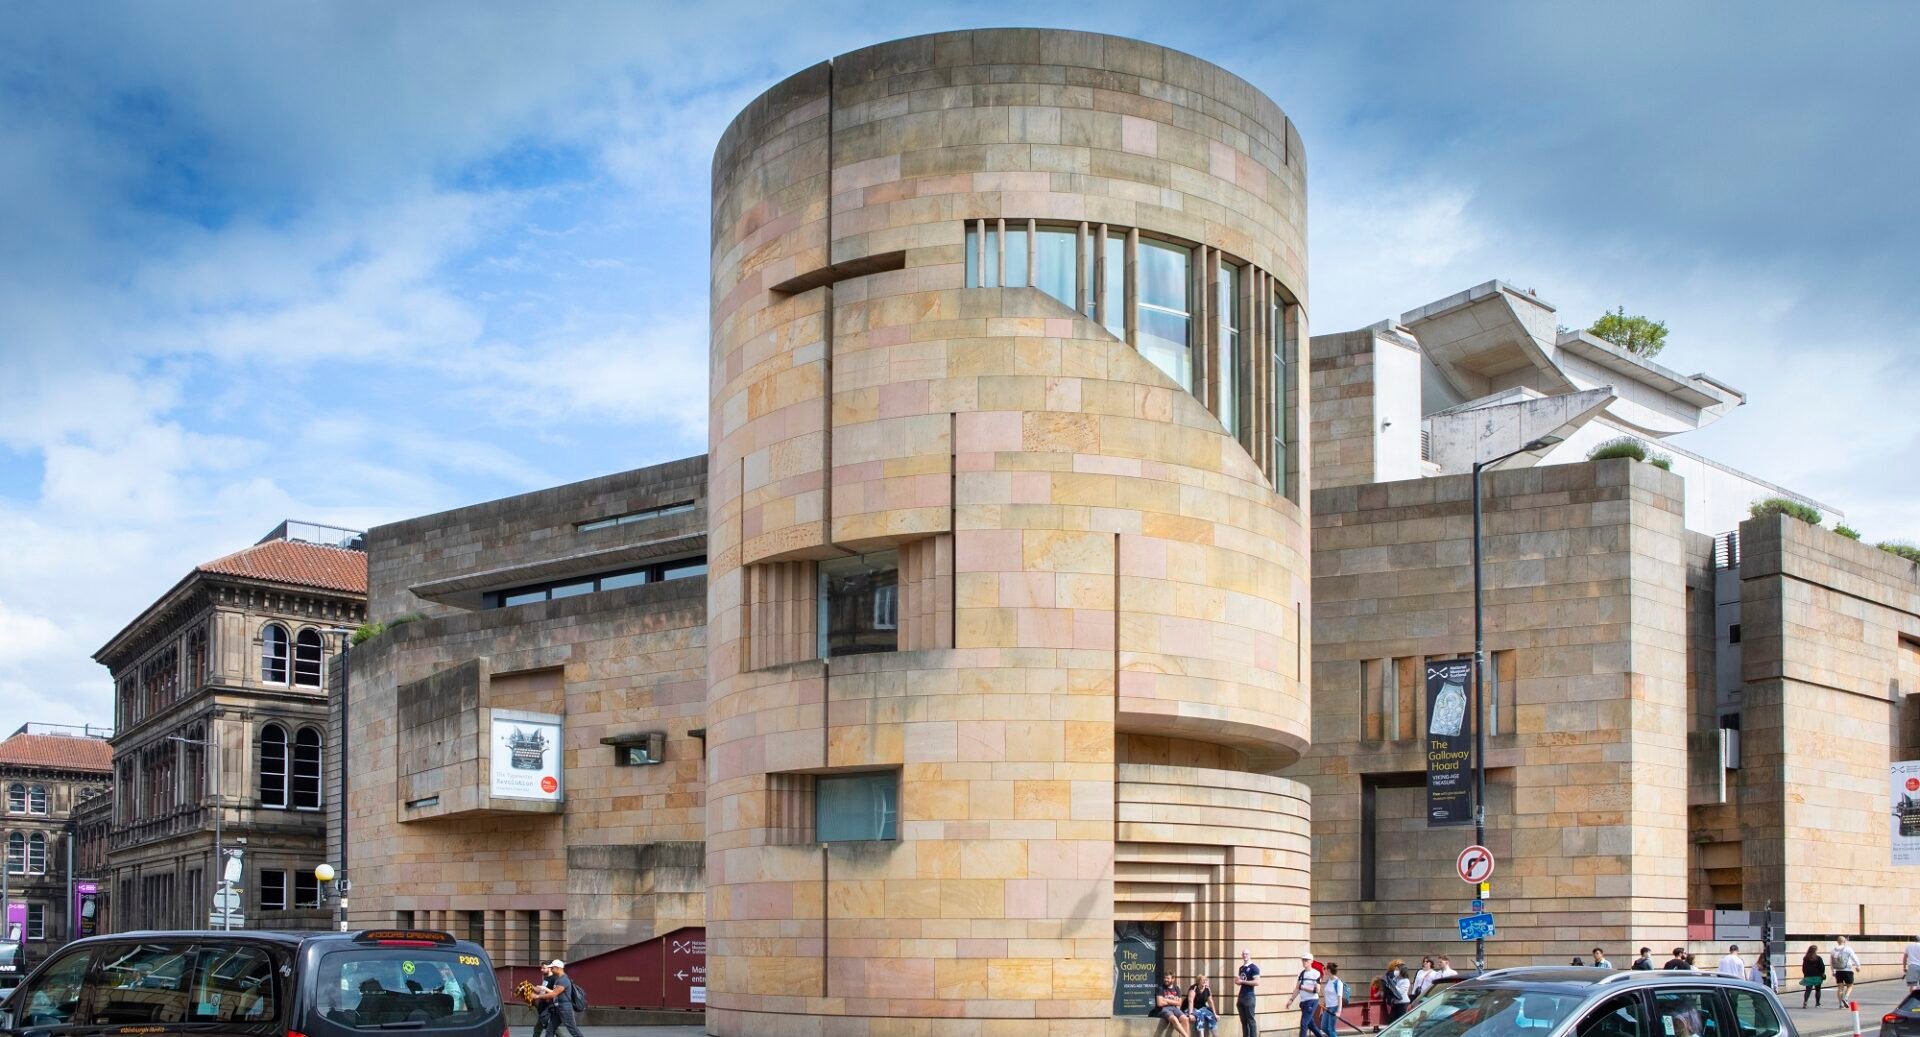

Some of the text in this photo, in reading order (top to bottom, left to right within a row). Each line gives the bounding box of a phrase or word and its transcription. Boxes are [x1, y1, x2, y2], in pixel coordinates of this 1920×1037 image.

[1432, 740, 1448, 749] The
[1428, 751, 1470, 760] Galloway
[1432, 760, 1459, 771] Hoard
[1123, 950, 1138, 960] The
[460, 956, 480, 966] P303
[1120, 962, 1156, 972] Galloway
[1124, 972, 1147, 981] Hoard
